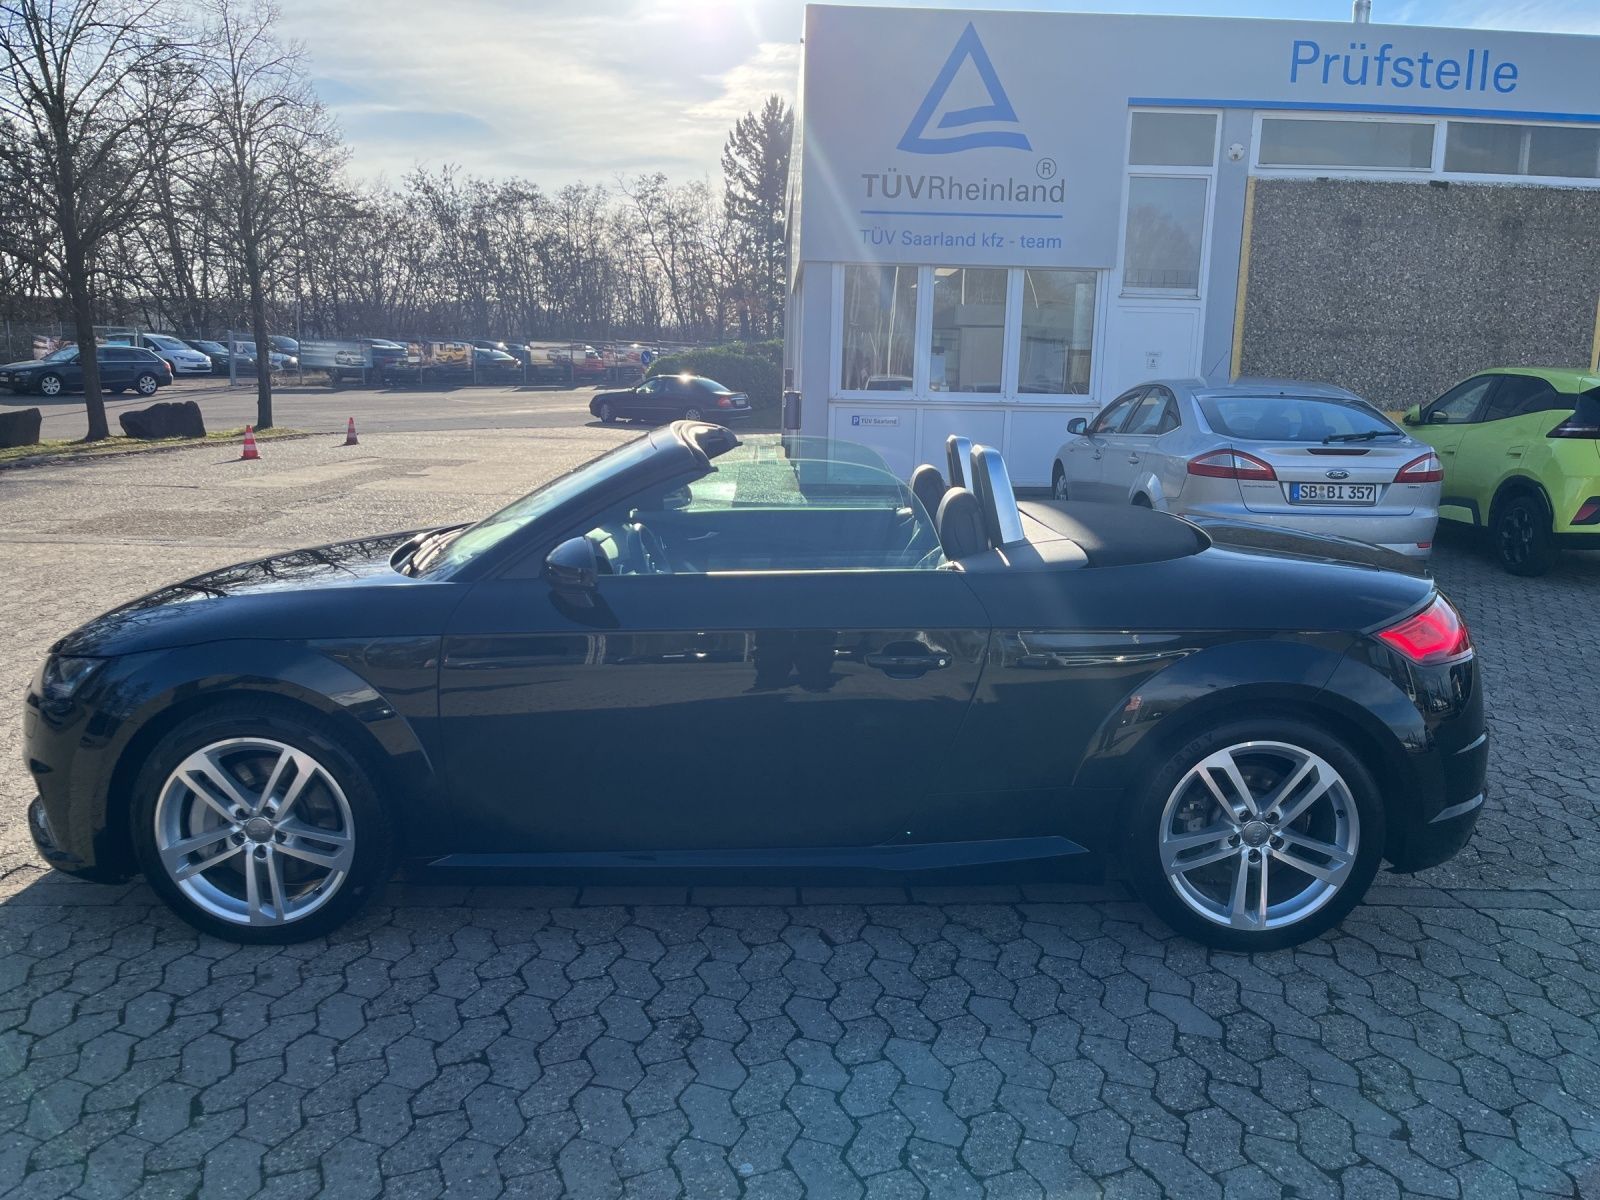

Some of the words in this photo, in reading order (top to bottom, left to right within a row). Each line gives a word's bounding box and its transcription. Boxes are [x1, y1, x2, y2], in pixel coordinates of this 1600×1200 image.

[1290, 40, 1519, 94] Prüfstelle
[859, 226, 896, 246] TÜV
[901, 230, 976, 247] Saarland
[981, 231, 1004, 248] kfz
[1020, 235, 1062, 249] team
[1300, 485, 1317, 498] SB
[1327, 486, 1344, 499] BI
[1349, 486, 1374, 500] 357
